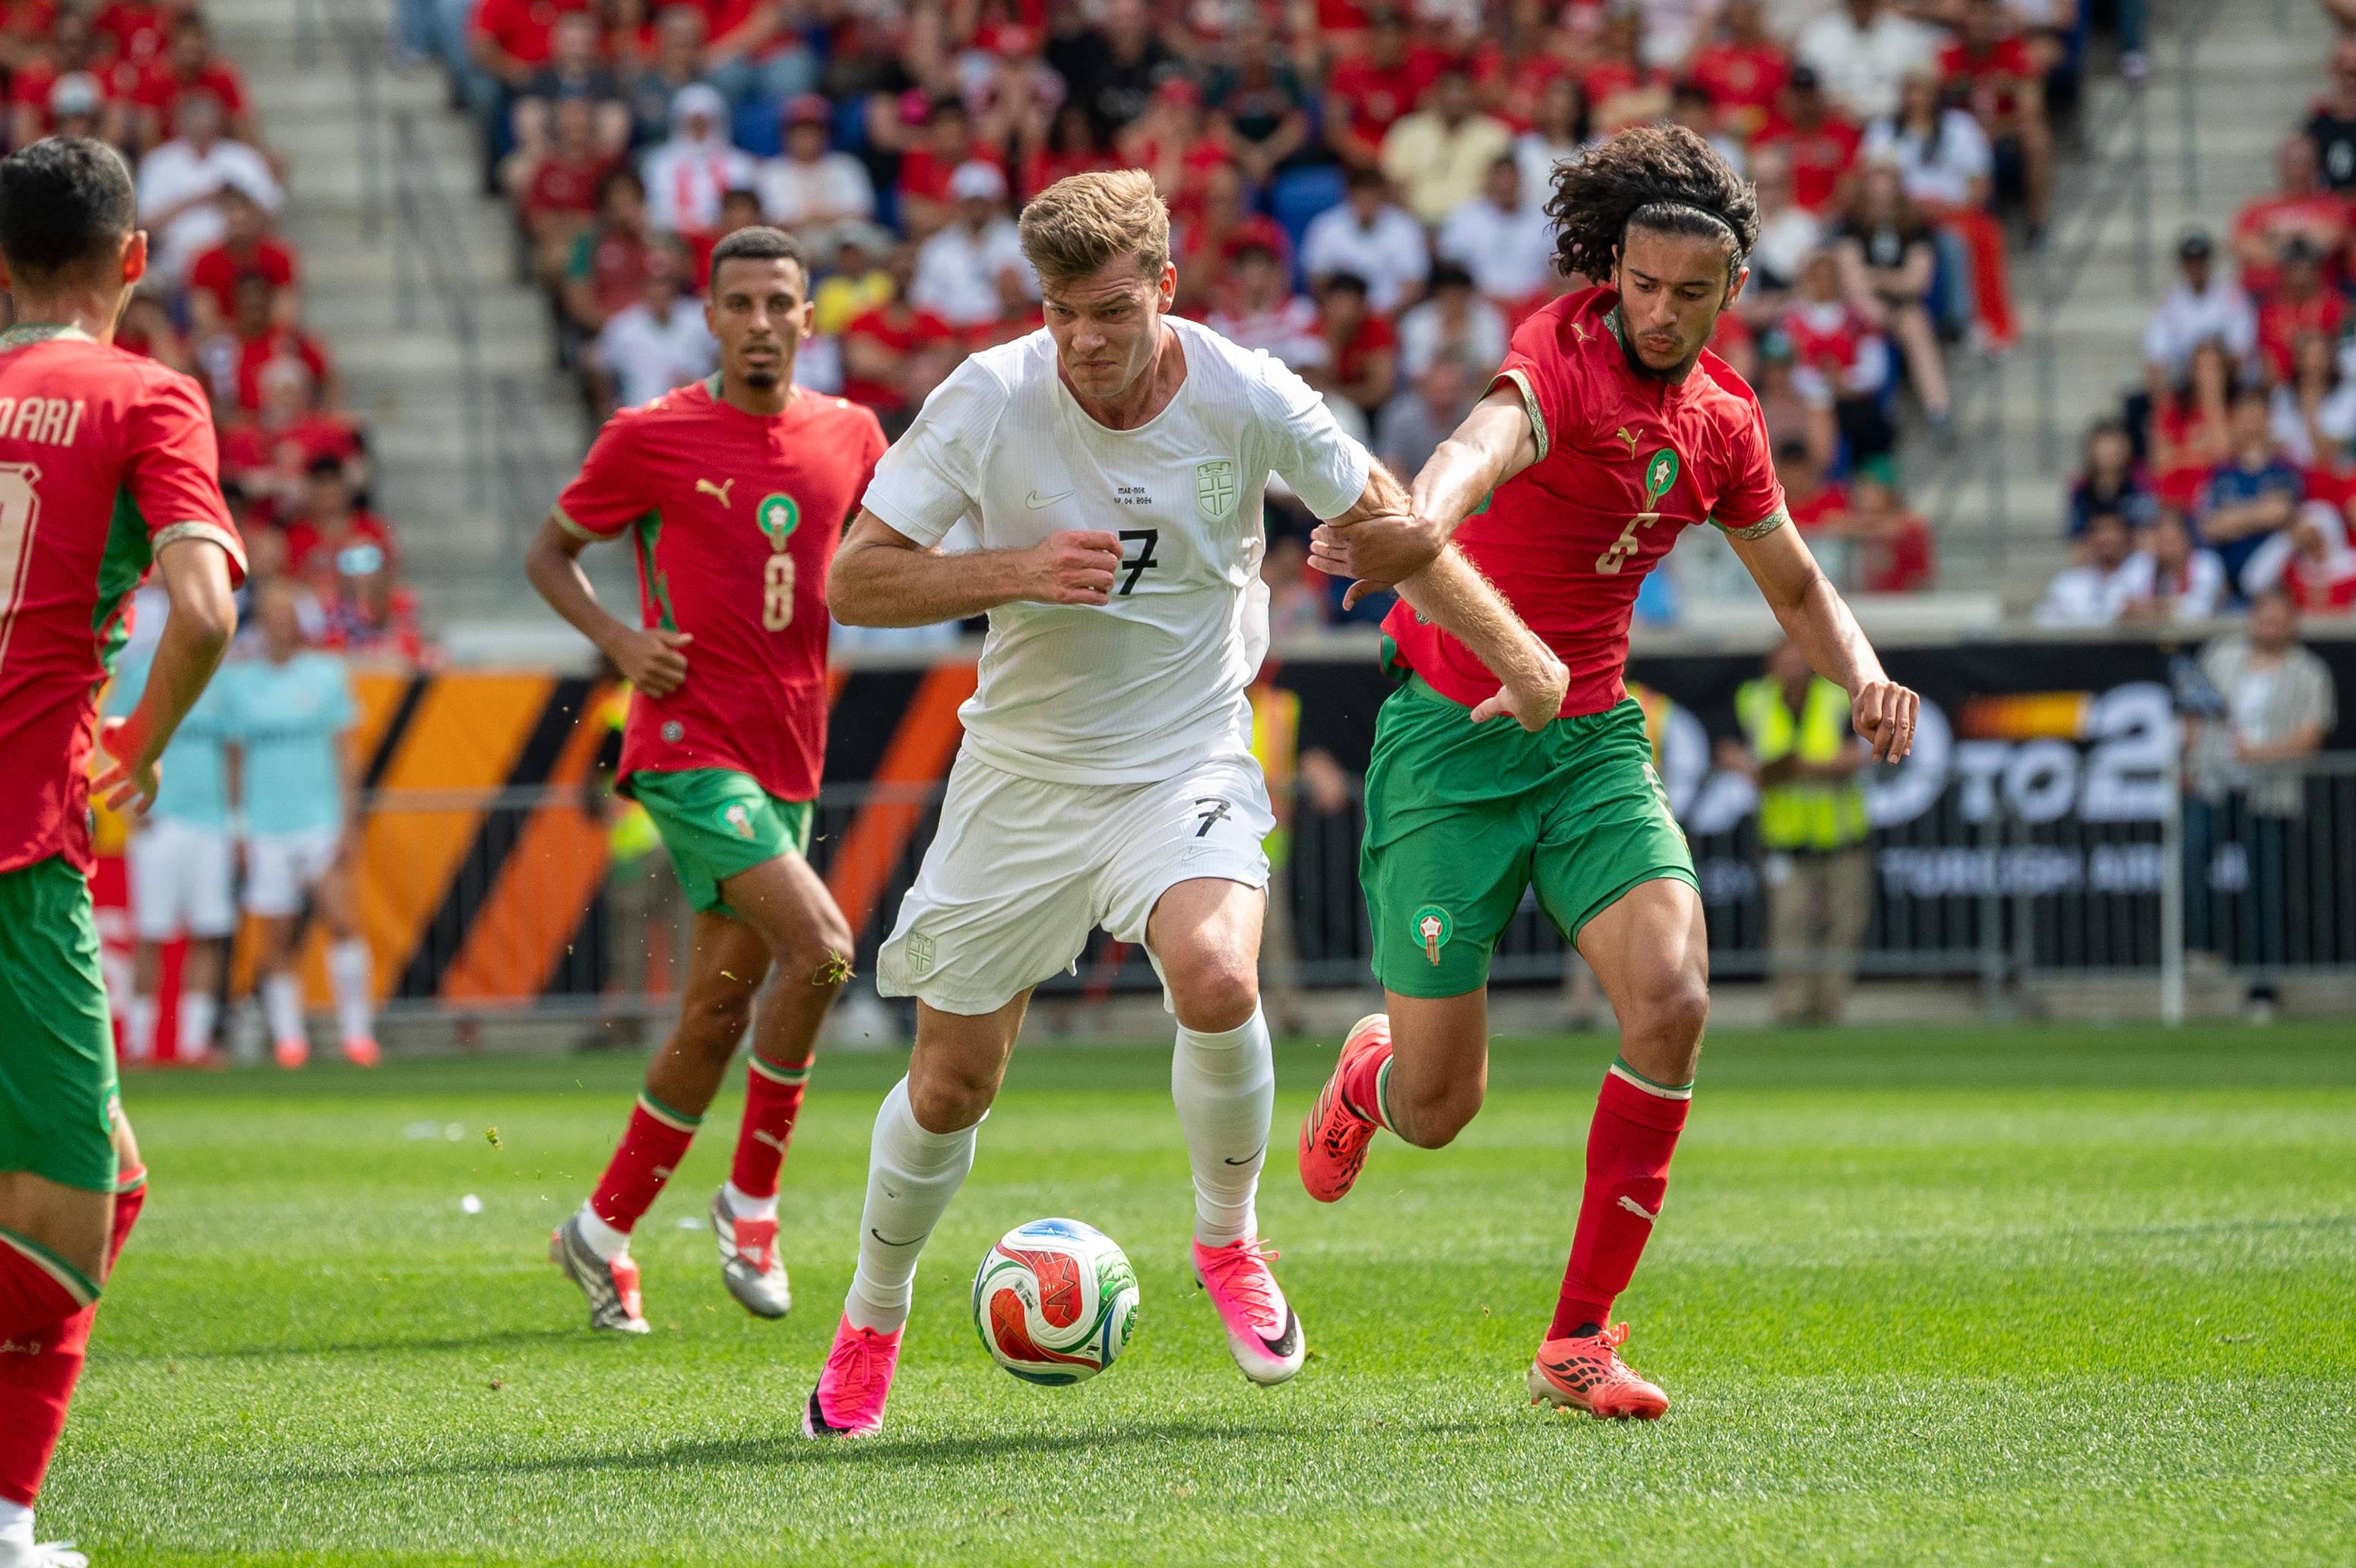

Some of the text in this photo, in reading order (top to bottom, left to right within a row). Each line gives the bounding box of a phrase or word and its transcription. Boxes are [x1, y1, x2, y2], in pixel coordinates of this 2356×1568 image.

[1119, 528, 1159, 595] 7
[1596, 512, 1661, 574] 6
[763, 553, 795, 632] 8
[1195, 798, 1231, 837] 7
